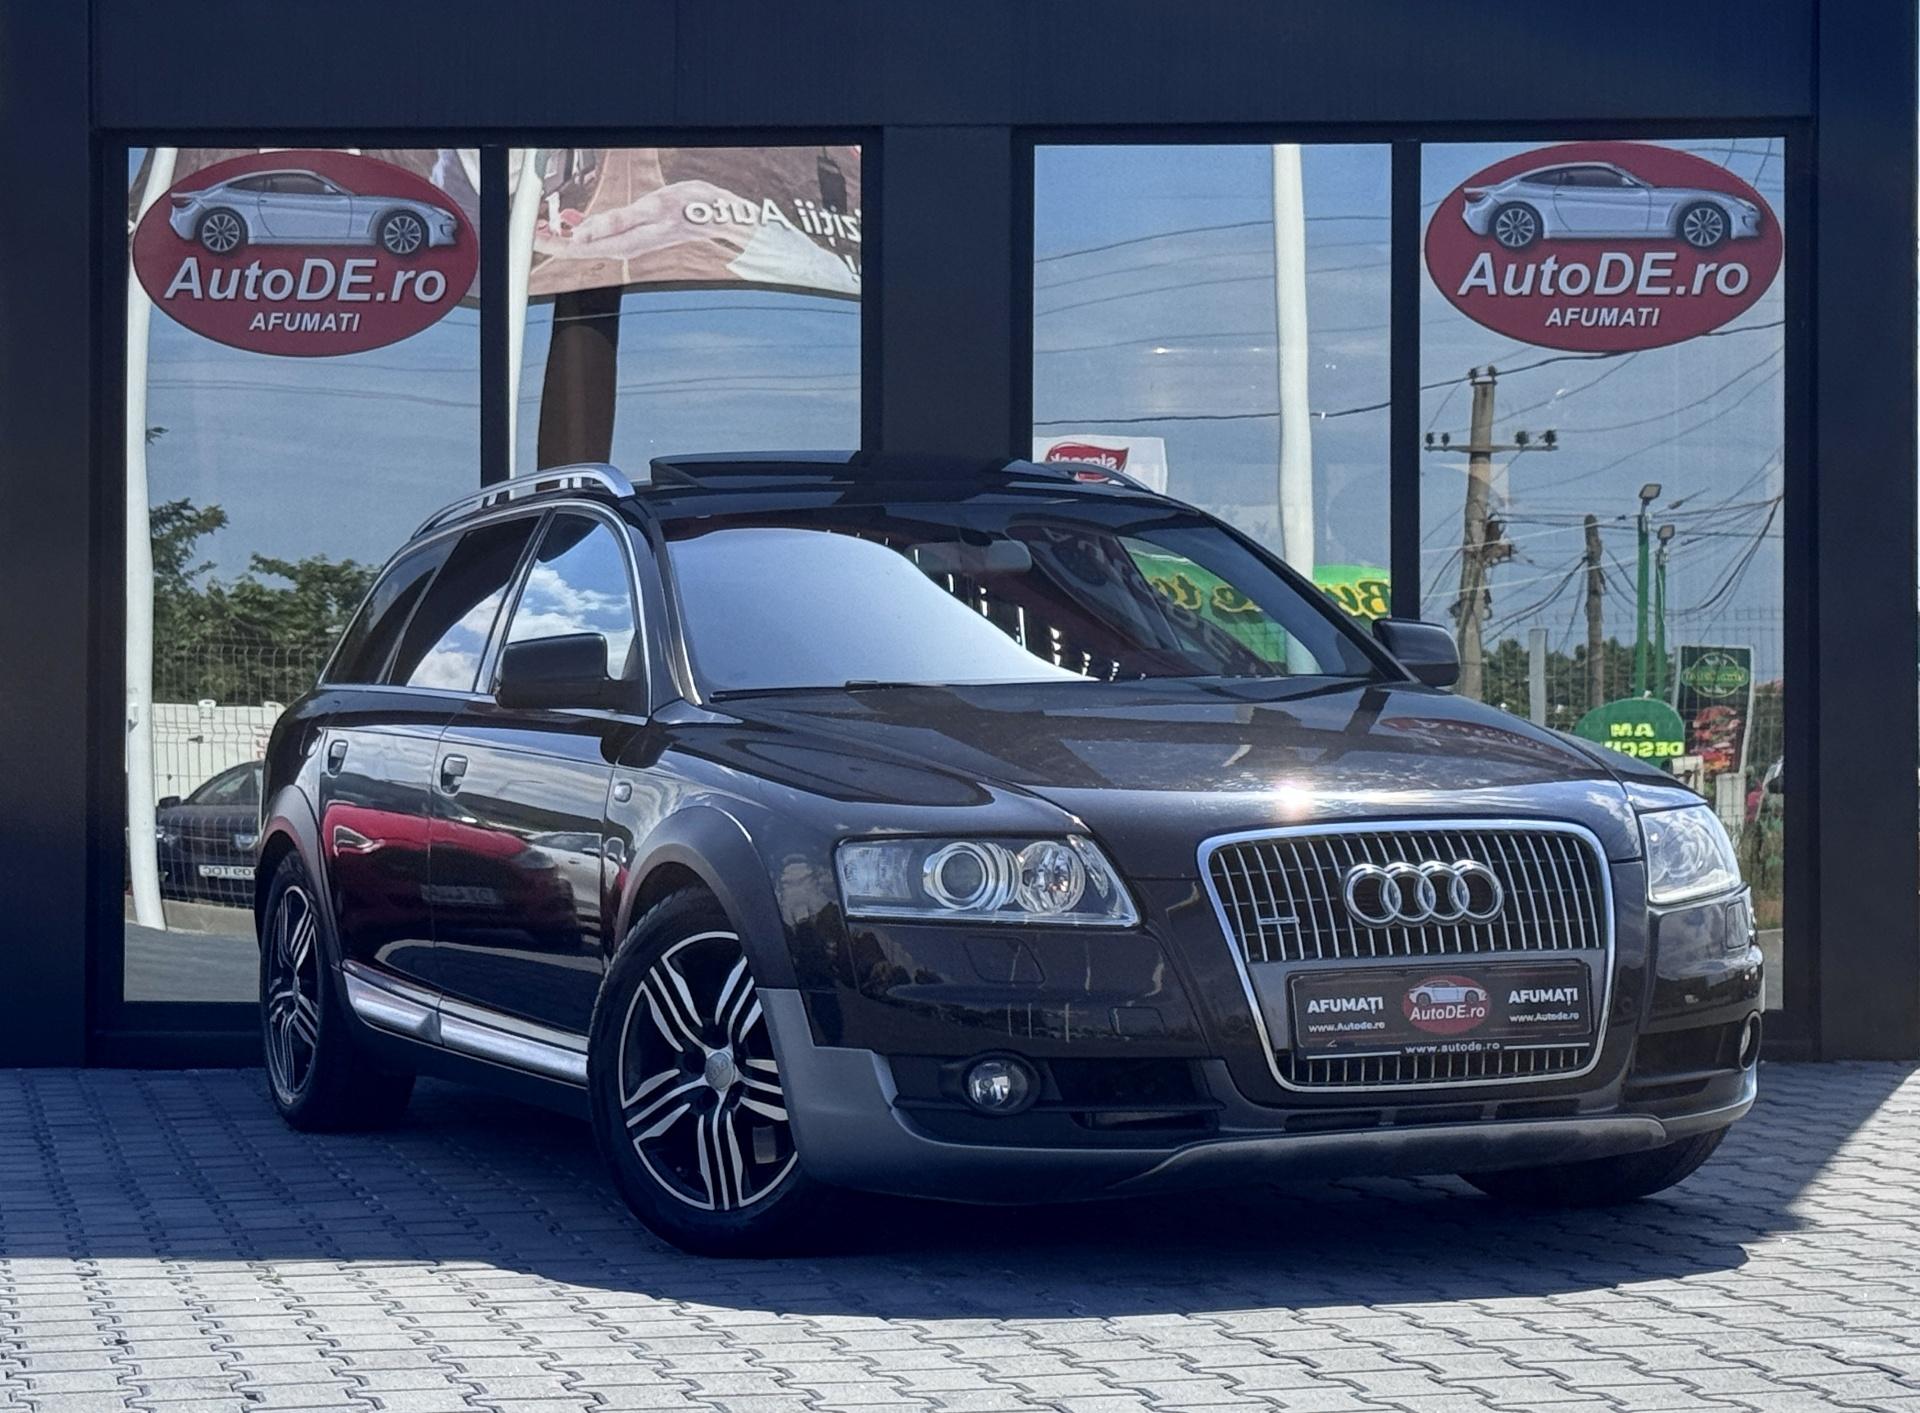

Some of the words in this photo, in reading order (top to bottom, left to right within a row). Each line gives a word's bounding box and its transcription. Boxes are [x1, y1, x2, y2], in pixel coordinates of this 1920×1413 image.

[163, 256, 447, 302] AutoDE.ro
[1456, 251, 1750, 297] AutoDE.ro
[249, 312, 361, 333] AFUMATI
[1545, 307, 1661, 328] AFUMATI
[1409, 1003, 1486, 1021] AutoDE.ro
[1404, 1041, 1501, 1054] www.autode.ro
